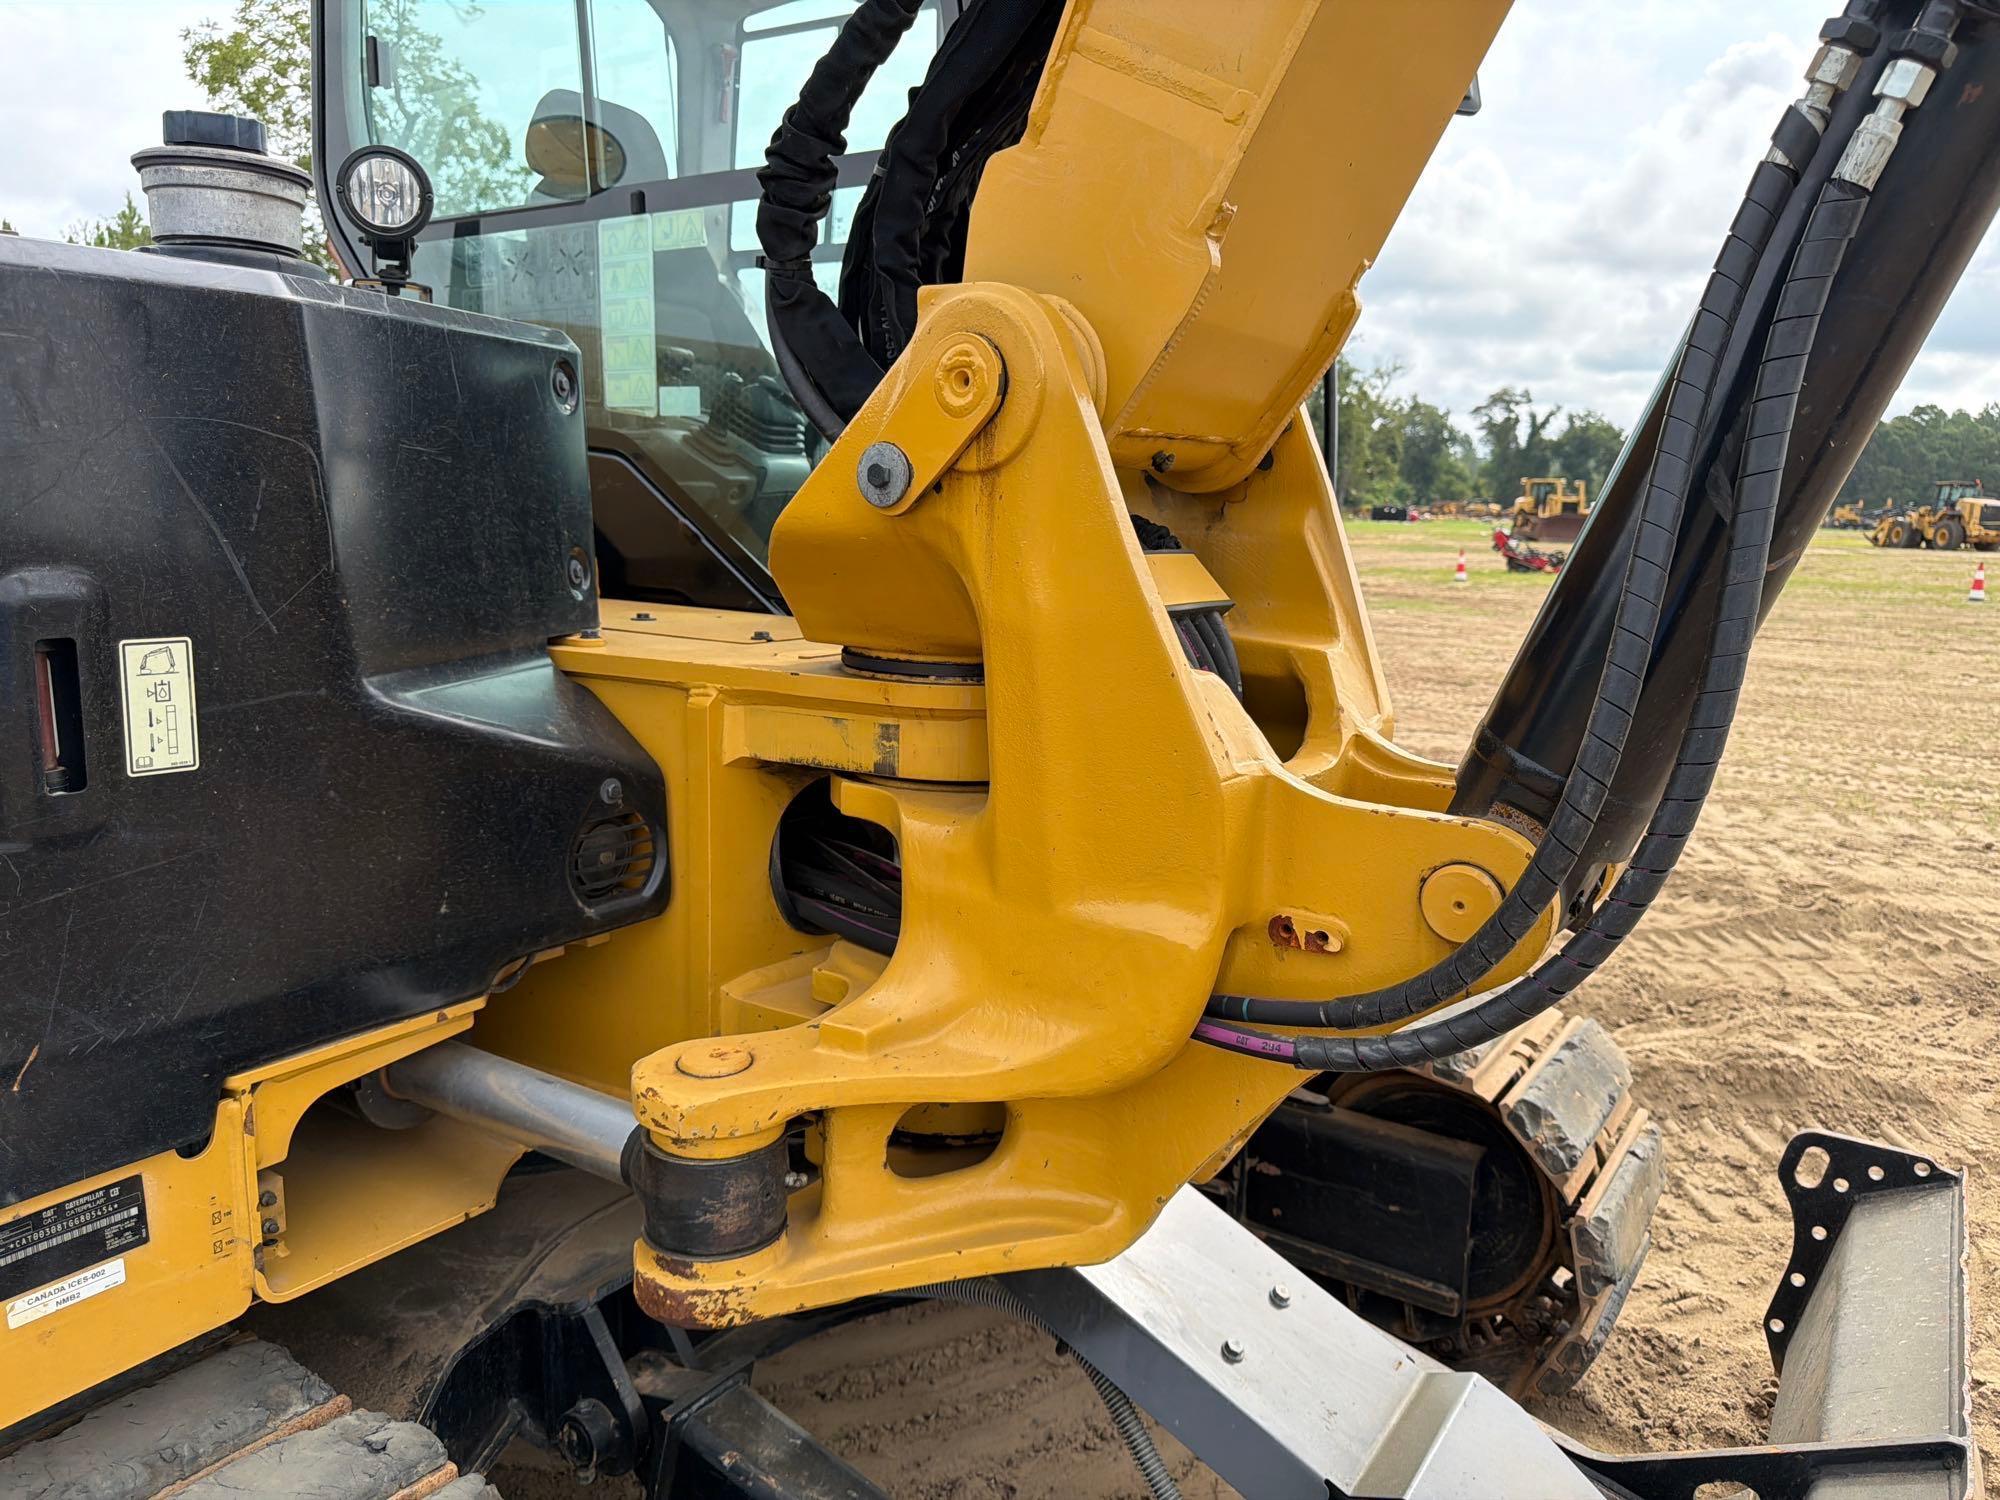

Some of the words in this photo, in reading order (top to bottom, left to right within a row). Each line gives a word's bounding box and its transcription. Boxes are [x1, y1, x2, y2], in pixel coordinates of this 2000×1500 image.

[65, 1191, 104, 1210] CATERPILLAR
[27, 1285, 65, 1306] CANADA
[68, 1269, 106, 1288] ICES-002
[56, 1292, 81, 1308] NMB2
